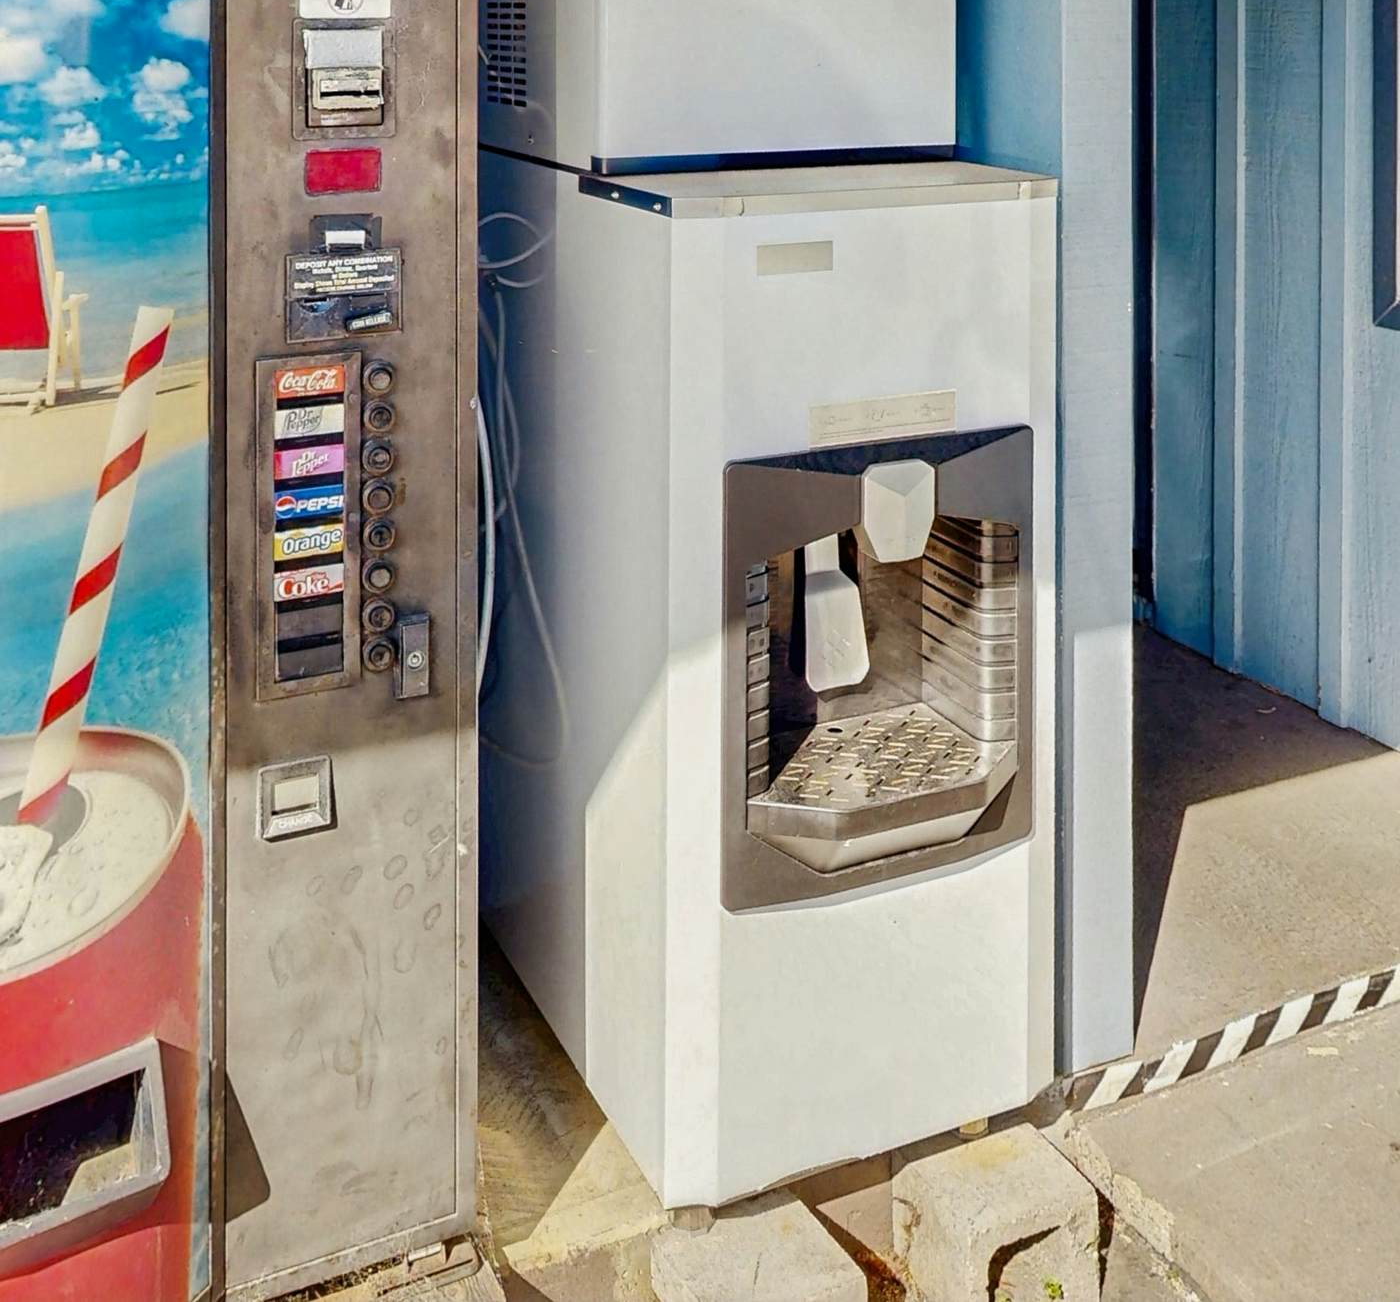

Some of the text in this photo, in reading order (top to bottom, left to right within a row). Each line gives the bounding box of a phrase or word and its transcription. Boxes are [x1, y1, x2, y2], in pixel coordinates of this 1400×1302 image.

[295, 261, 327, 270] DEPOSIT
[344, 256, 393, 265] COMBINATION
[286, 411, 320, 431] Pepper
[291, 454, 329, 477] Pepper
[302, 451, 317, 463] Dr
[296, 495, 344, 513] PEPSI
[283, 529, 342, 555] Orange
[279, 576, 329, 598] Coke
